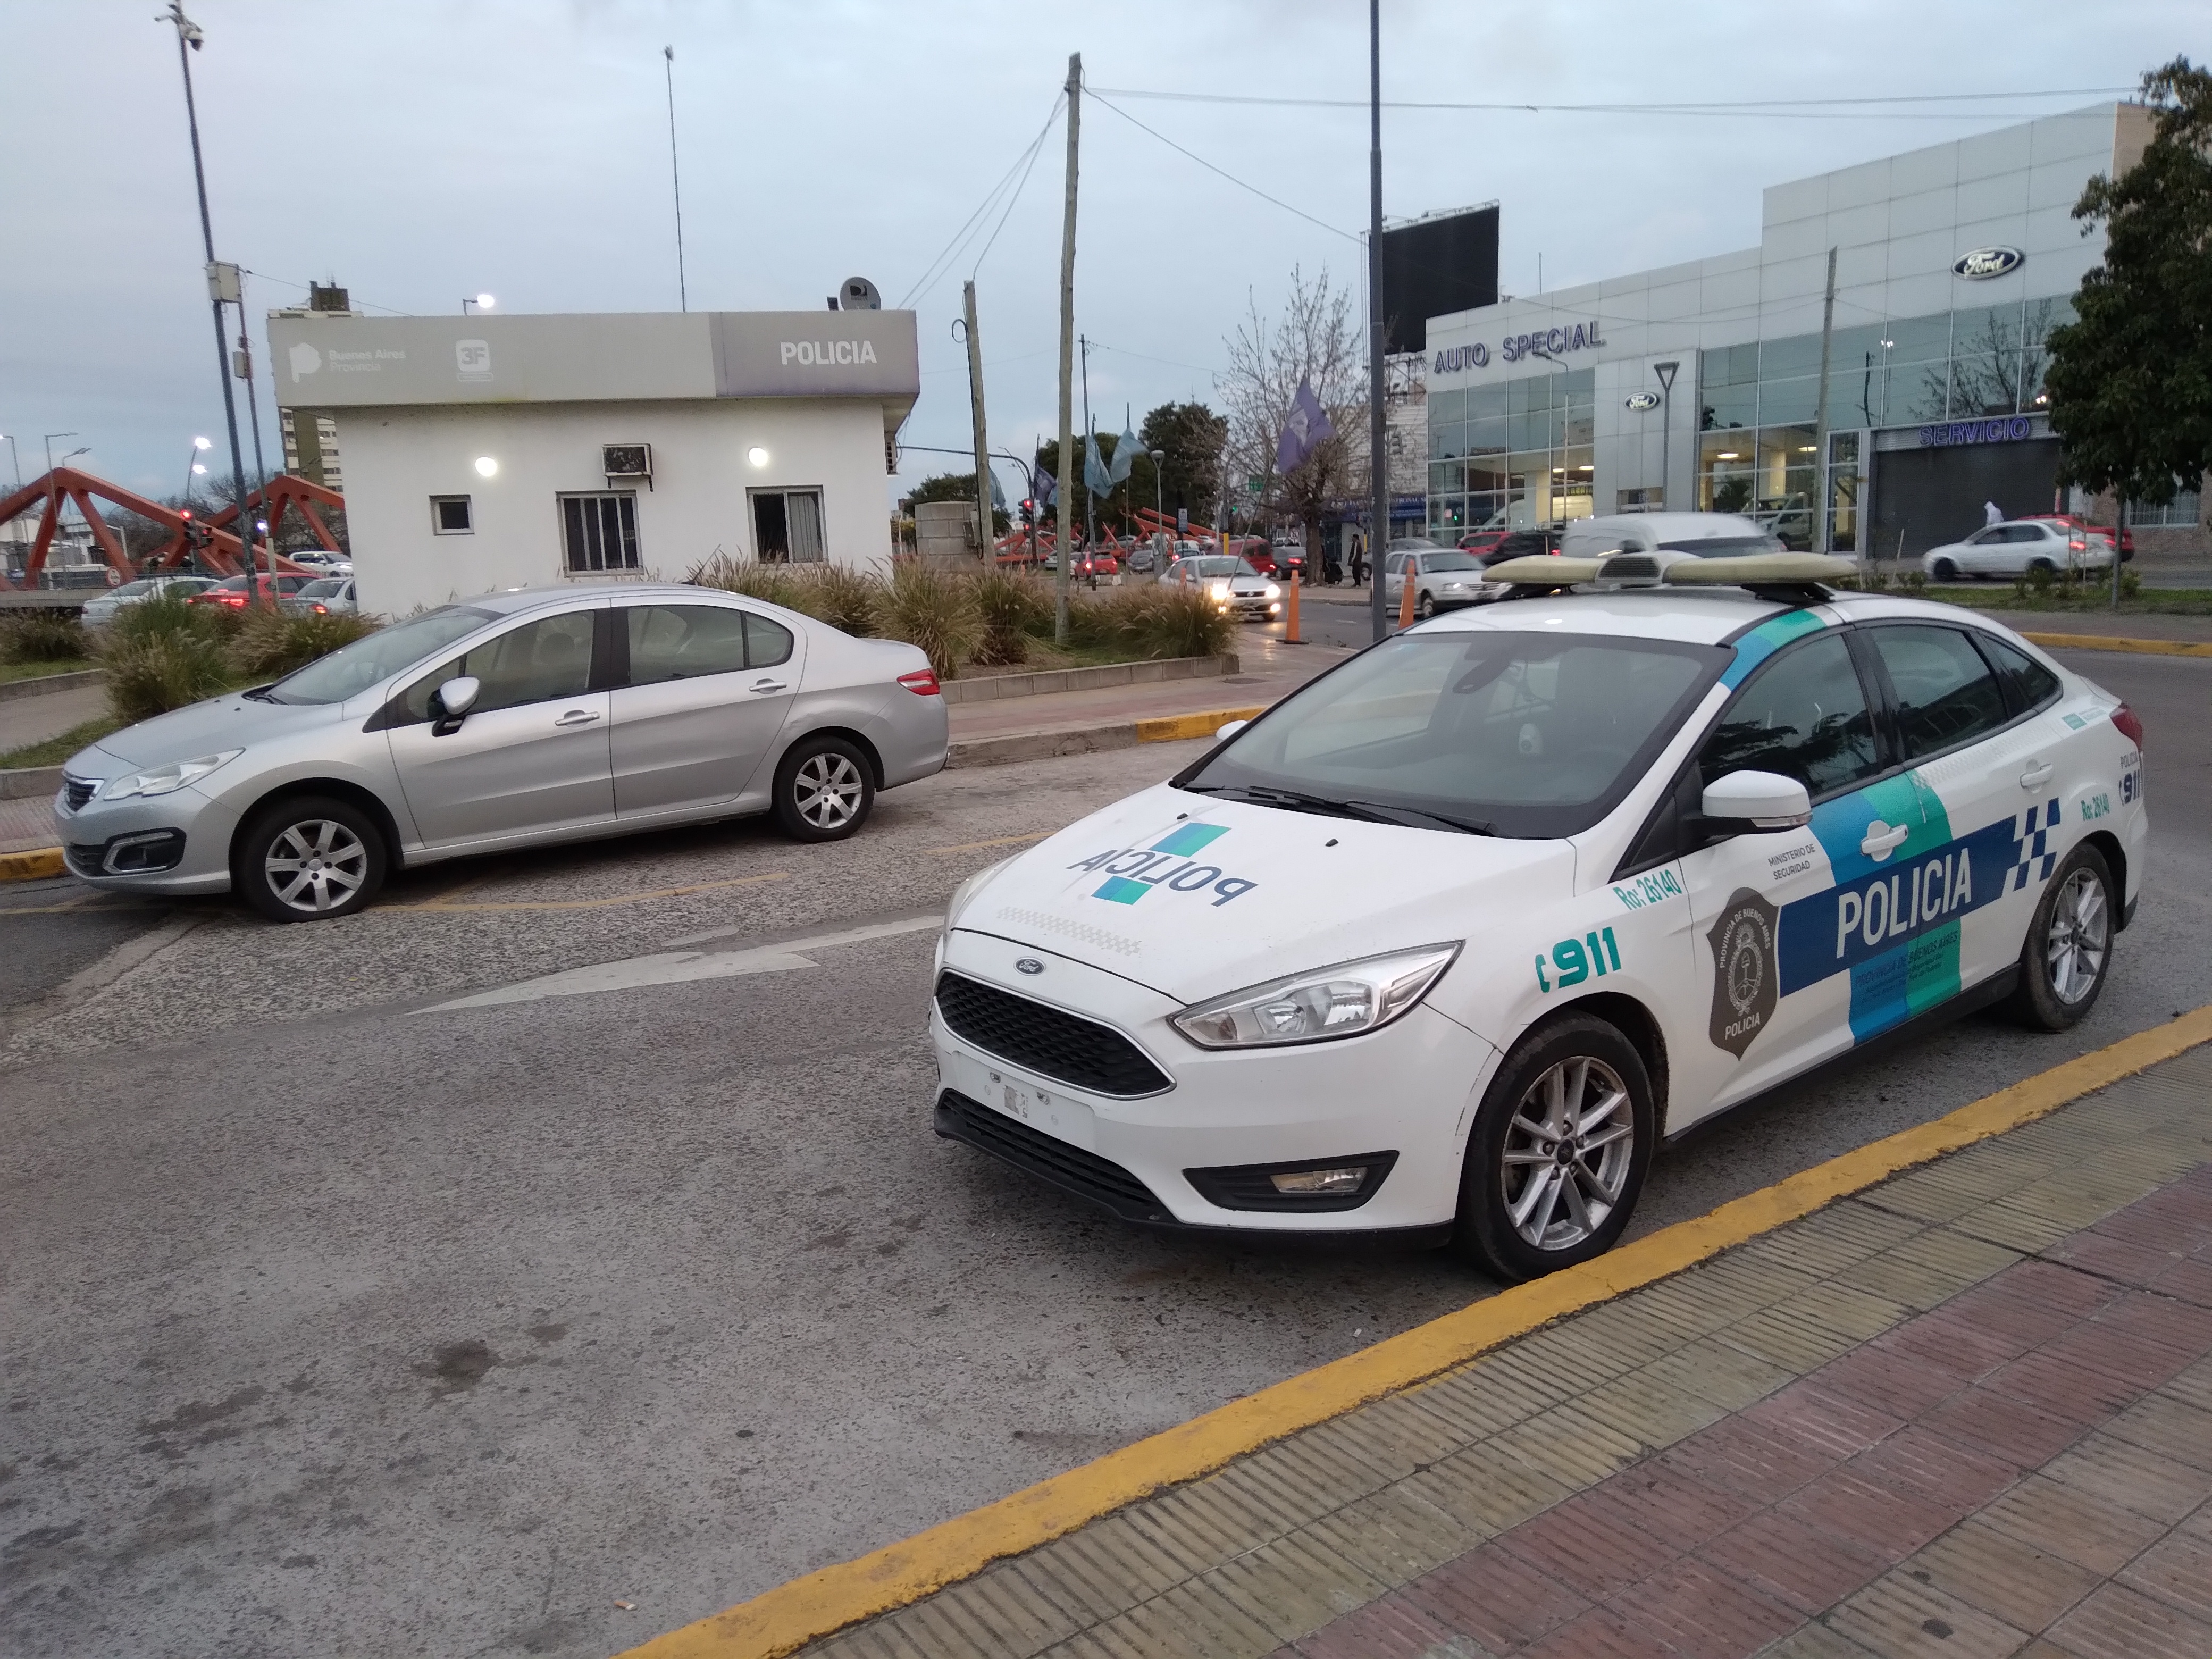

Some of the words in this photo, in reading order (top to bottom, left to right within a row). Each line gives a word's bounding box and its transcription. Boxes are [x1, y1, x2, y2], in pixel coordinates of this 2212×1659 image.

[1964, 252, 2005, 279] Ford
[329, 350, 372, 361] Buenos
[375, 349, 406, 359] Aires
[460, 346, 485, 365] 3F
[780, 340, 877, 365] POLICIA
[1434, 342, 1489, 374] AUTO
[1503, 320, 1605, 362] SPECIAL
[330, 362, 381, 372] Provincia
[1629, 395, 1649, 409] Ford
[1919, 416, 2029, 447] SERVICIO
[2124, 769, 2140, 804] 911
[1767, 847, 1806, 867] MINISTERIO
[1805, 843, 1816, 853] DE
[1773, 860, 1811, 880] SEGURIDAD
[1613, 887, 1646, 910] Ro:
[1636, 869, 1682, 903] 26140
[1837, 848, 1971, 959] POLICIA
[1720, 920, 1736, 968] PROVINCIA
[1734, 910, 1743, 923] DE
[1743, 908, 1764, 926] BUENOS
[1762, 925, 1771, 949] AIRES
[1019, 960, 1039, 972] Ford
[1552, 926, 1622, 988] 911
[1725, 1012, 1761, 1040] POLICIA
